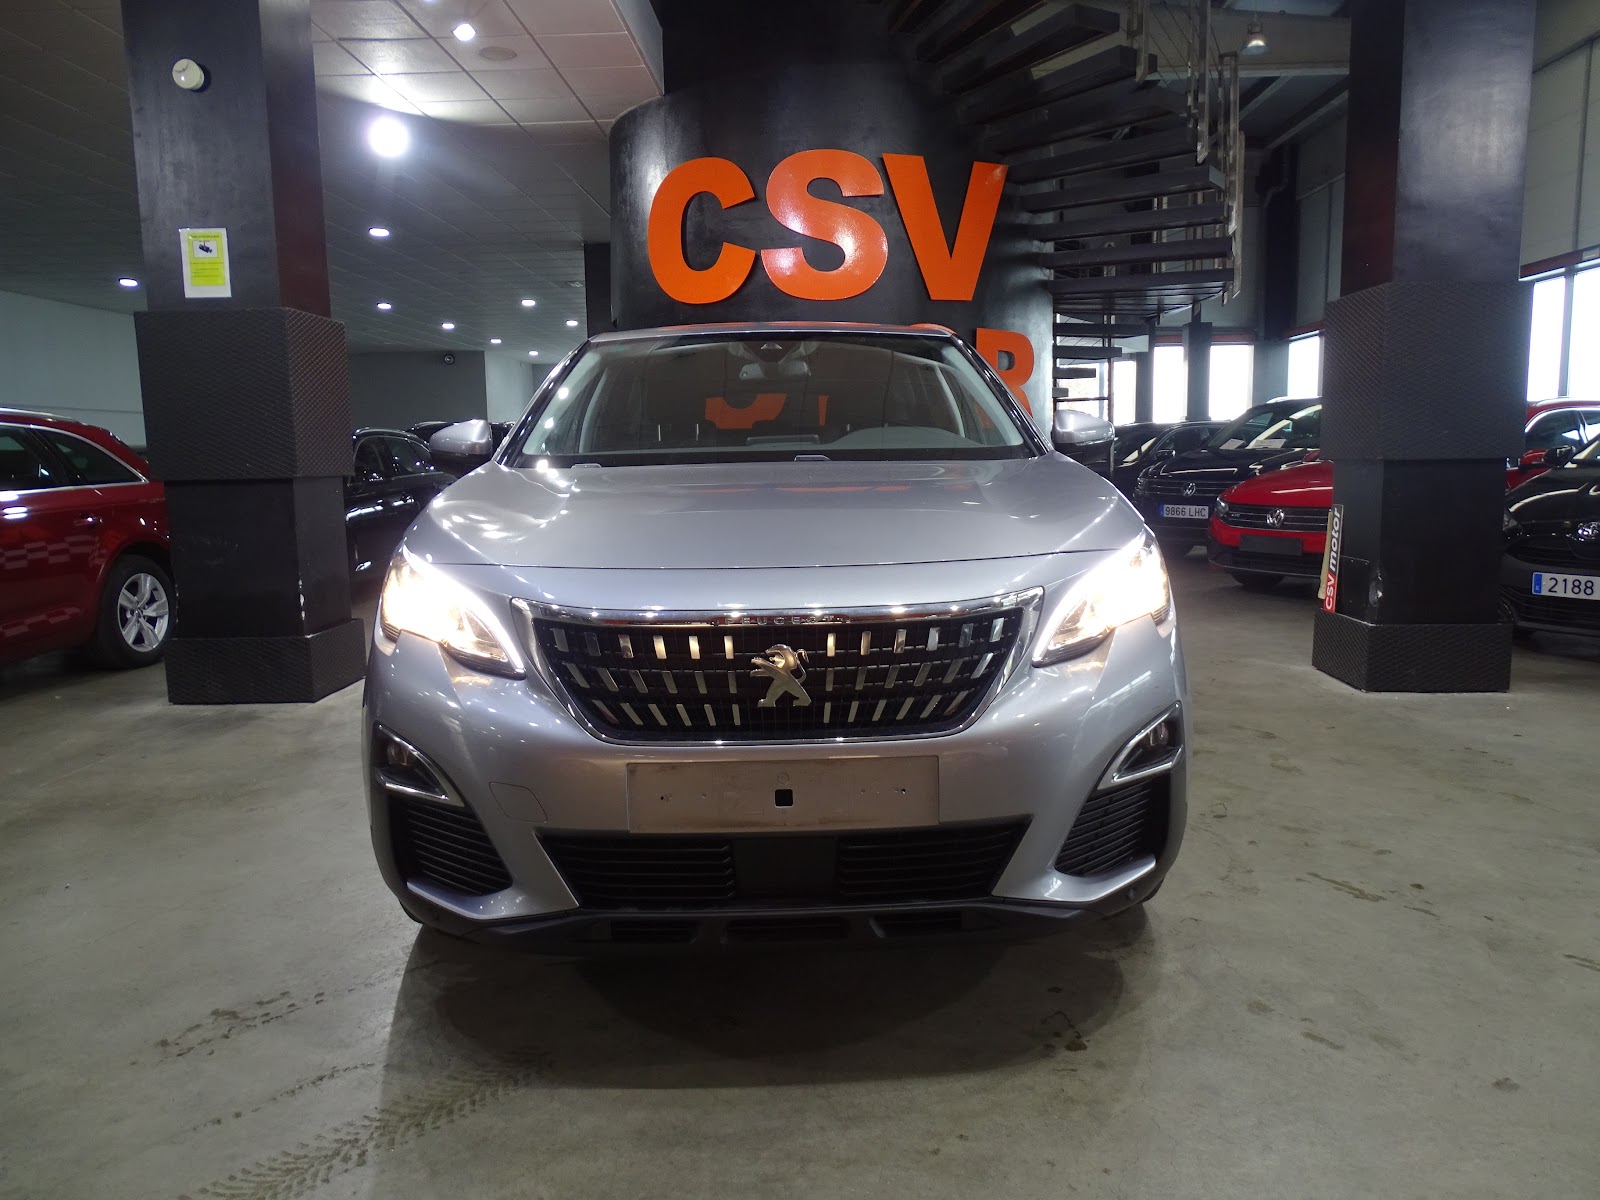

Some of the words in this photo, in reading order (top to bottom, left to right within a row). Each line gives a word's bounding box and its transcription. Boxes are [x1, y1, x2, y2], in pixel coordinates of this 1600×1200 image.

[647, 149, 1009, 305] CSV
[1165, 506, 1186, 516] 9866
[1188, 507, 1206, 517] LHC
[1329, 507, 1341, 572] motor
[1547, 577, 1594, 596] 2188
